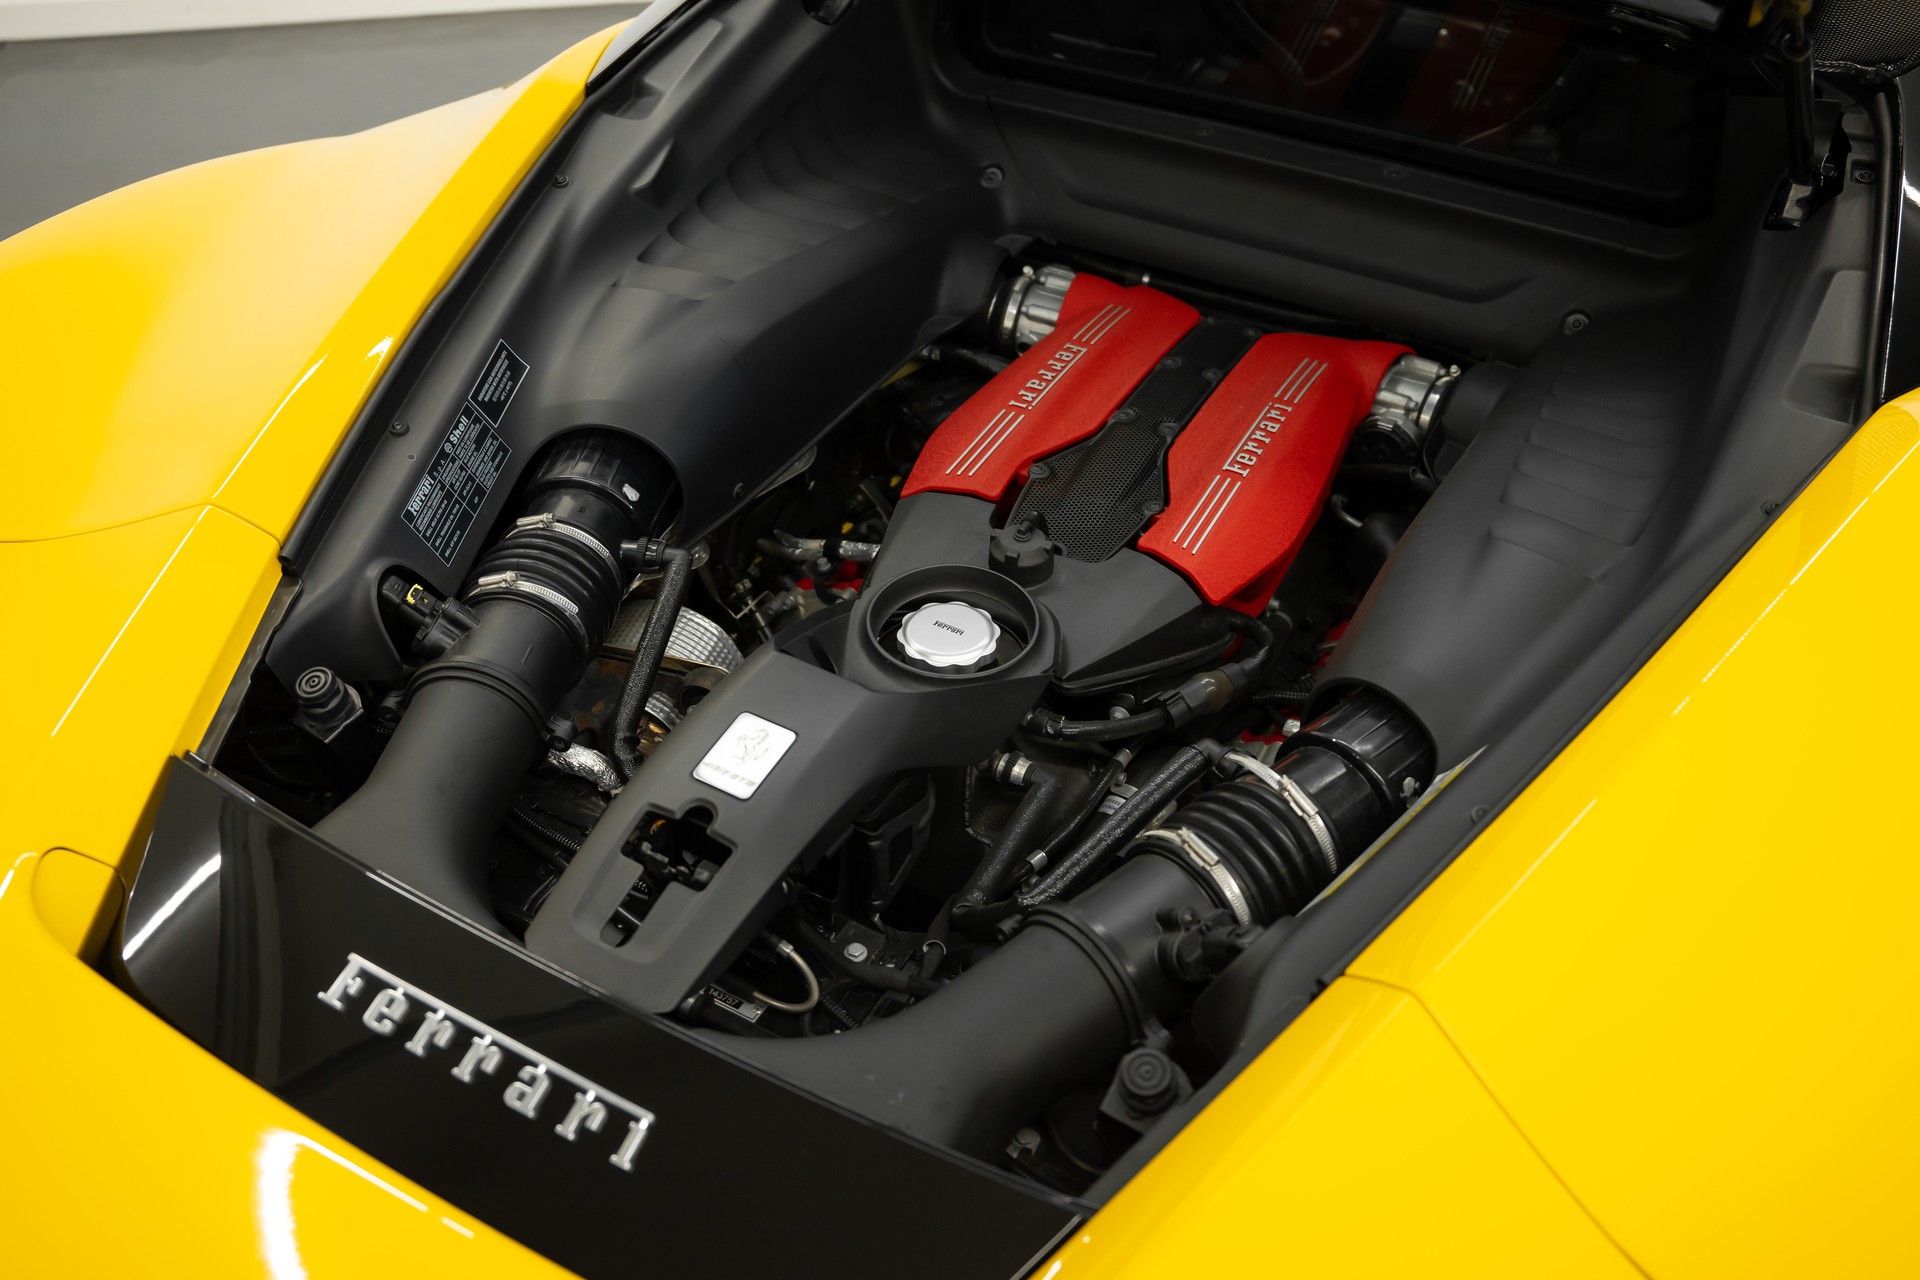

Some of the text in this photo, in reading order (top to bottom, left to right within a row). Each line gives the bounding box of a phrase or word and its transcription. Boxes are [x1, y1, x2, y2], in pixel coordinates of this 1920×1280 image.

[1008, 342, 1087, 411] Ferrari
[449, 414, 468, 444] Shell
[1222, 401, 1294, 478] Ferrari
[408, 456, 446, 517] Ferrari S.p.A.
[932, 620, 965, 636] Ferrari
[708, 988, 740, 1006] 143757
[317, 952, 655, 1171] Ferrari
